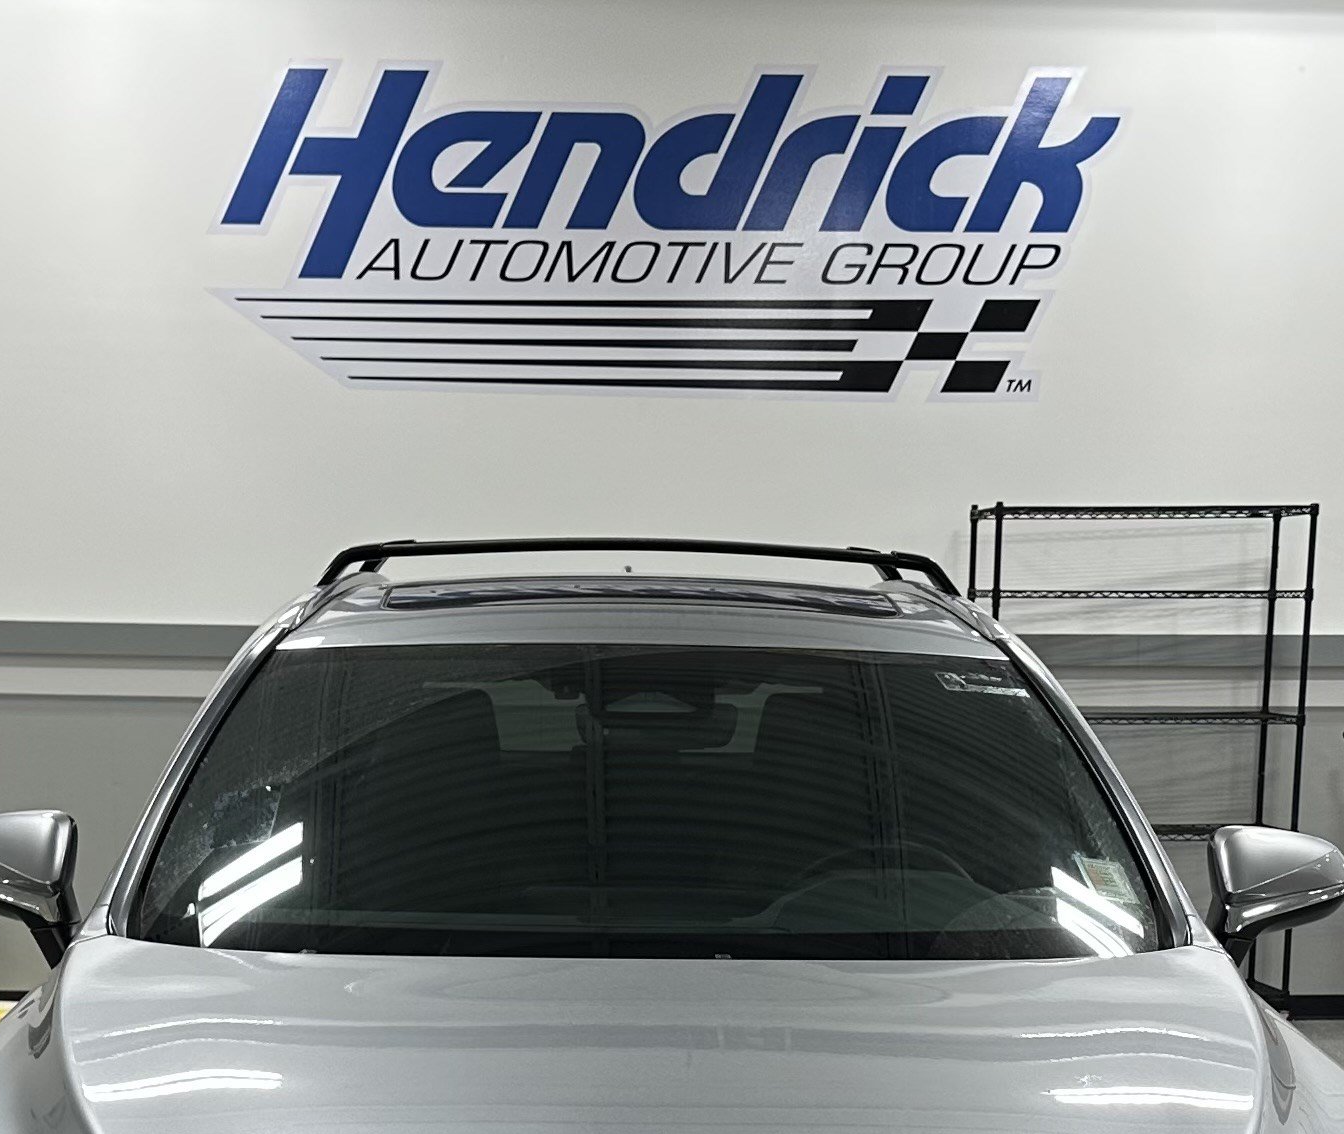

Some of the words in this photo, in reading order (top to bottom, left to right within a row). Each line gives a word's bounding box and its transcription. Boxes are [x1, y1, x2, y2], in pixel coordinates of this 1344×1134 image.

[221, 68, 1120, 279] Hendrick
[357, 238, 803, 285] AUTOMOTIVE
[821, 241, 1061, 287] GROUP
[1005, 380, 1032, 393] TM
